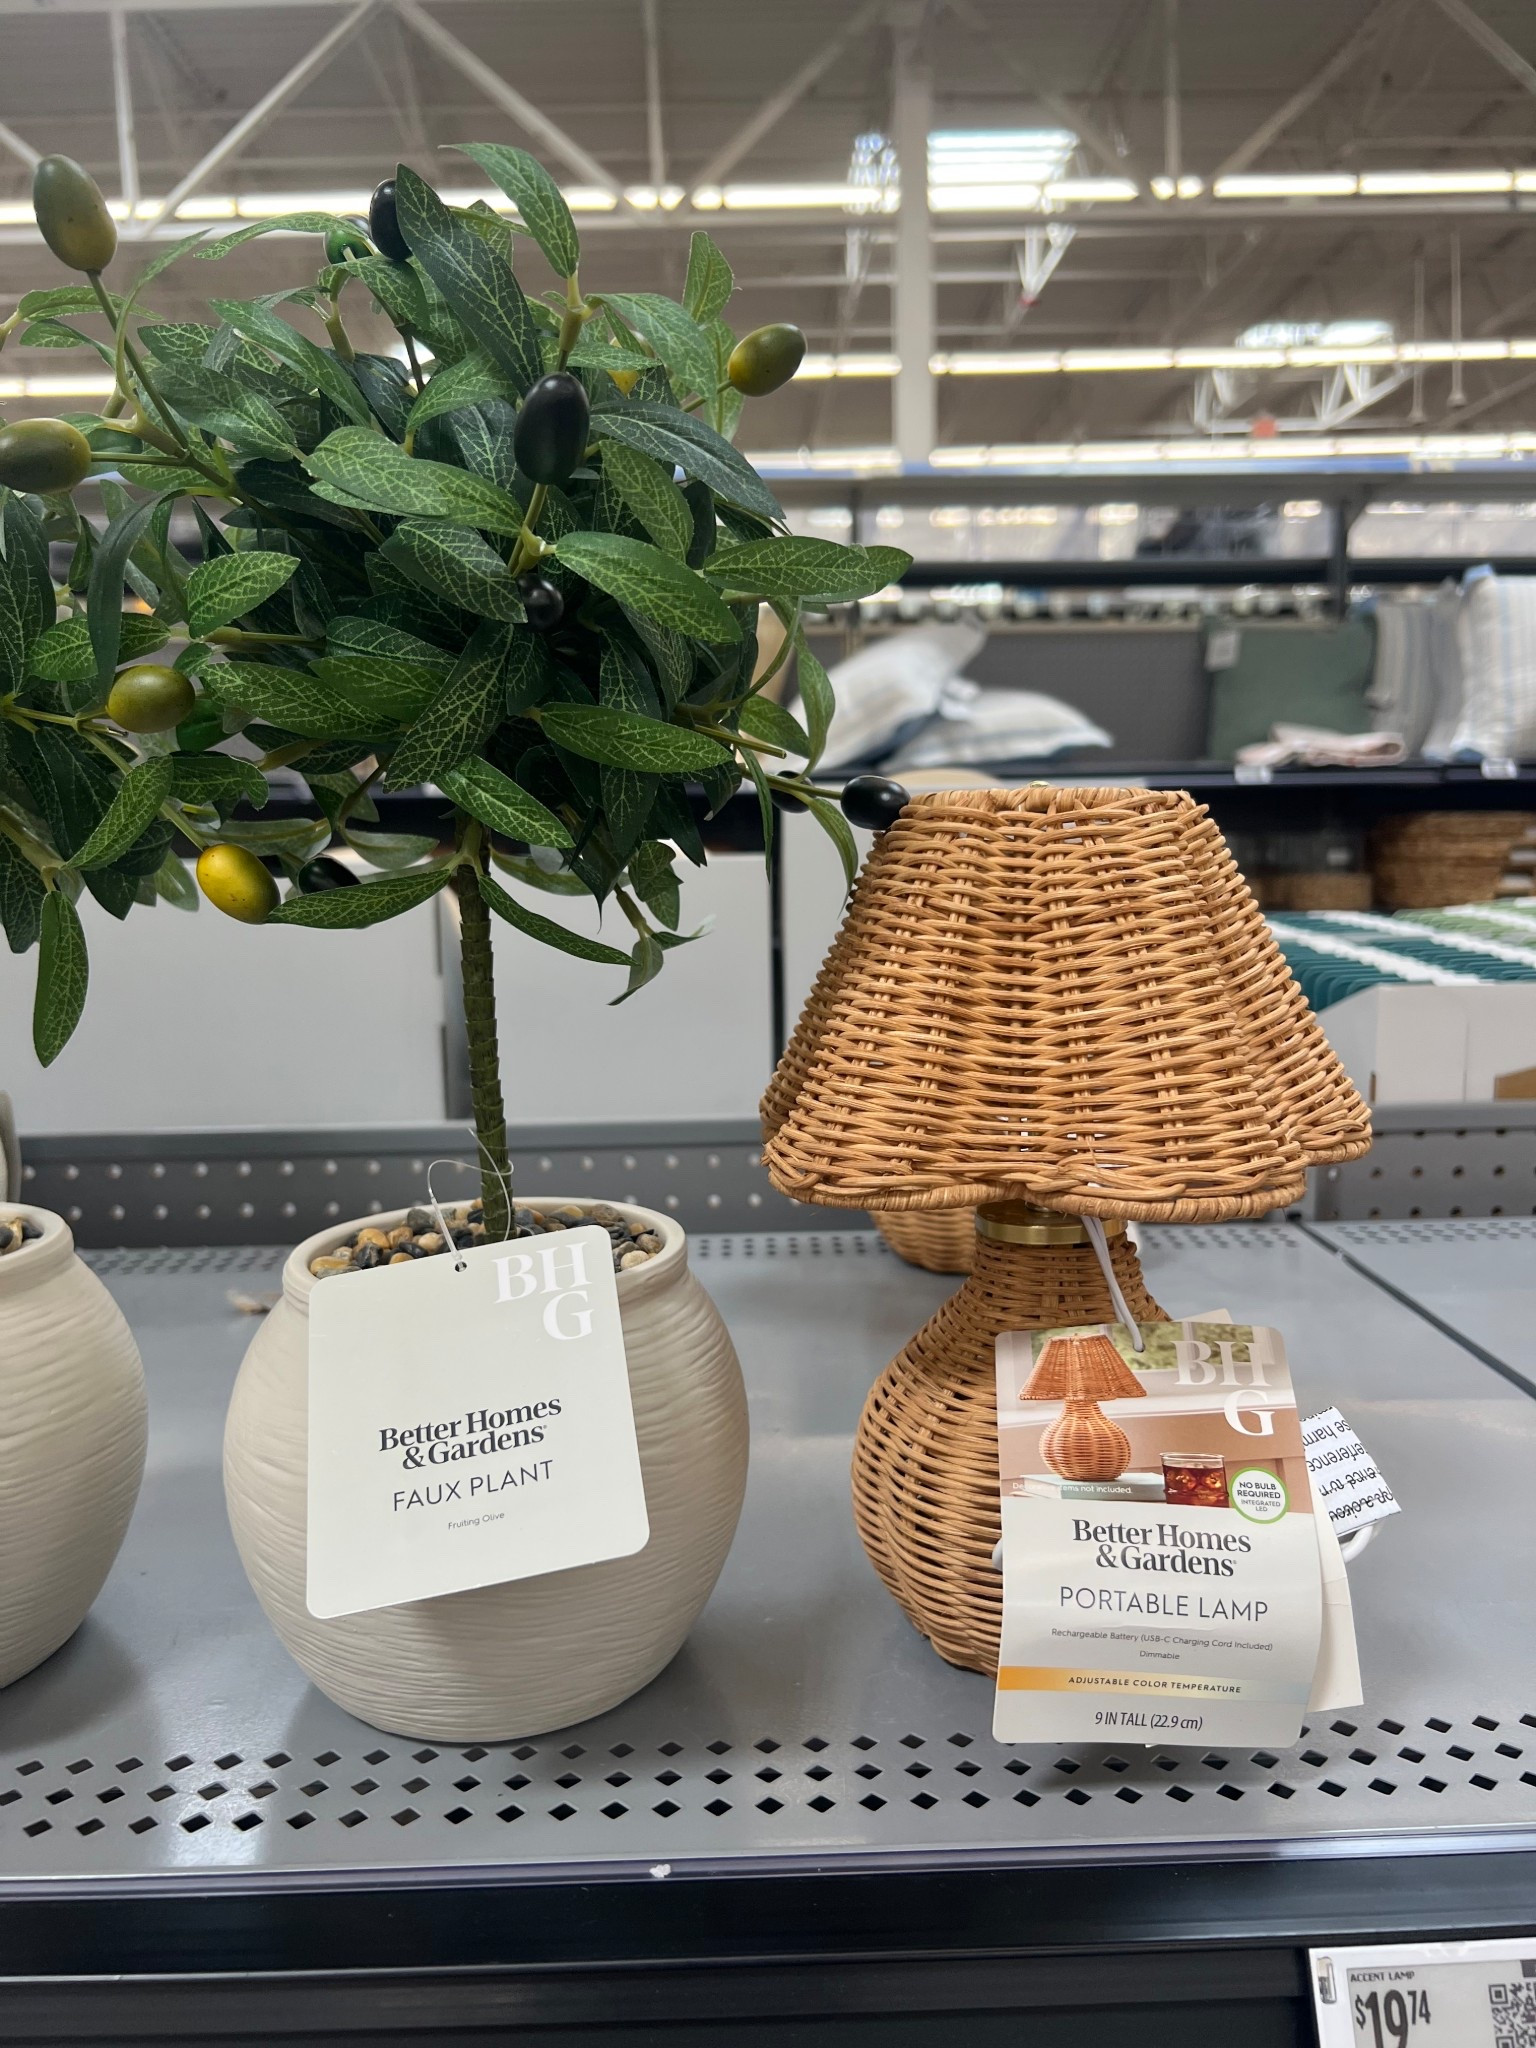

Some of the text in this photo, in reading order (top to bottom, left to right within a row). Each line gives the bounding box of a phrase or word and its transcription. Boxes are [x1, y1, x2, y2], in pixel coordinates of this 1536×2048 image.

[492, 1241, 593, 1304] BH
[542, 1290, 595, 1340] G
[379, 1398, 561, 1452] Better Homes
[1224, 1390, 1275, 1436] G
[1302, 1425, 1338, 1447] harm
[1306, 1443, 1368, 1472] erference
[393, 1459, 553, 1511] FAUX PLANT
[1237, 1490, 1280, 1498] REQUIRED
[448, 1512, 505, 1530] Fruiting Olive
[1072, 1519, 1251, 1553] Better Homes
[1060, 1586, 1268, 1622] PORTABLE LAMP
[1051, 1628, 1273, 1652] Rechargeable Battery (USB-C Charging Cord Included)
[1139, 1650, 1179, 1660] Dimmable
[1068, 1676, 1241, 1693] ADJUSTABLE COLOR TEMPERATURE
[1095, 1712, 1203, 1731] 9 IN TALL (22.9 cm)
[1351, 1971, 1415, 1982] ACCENT LAMP
